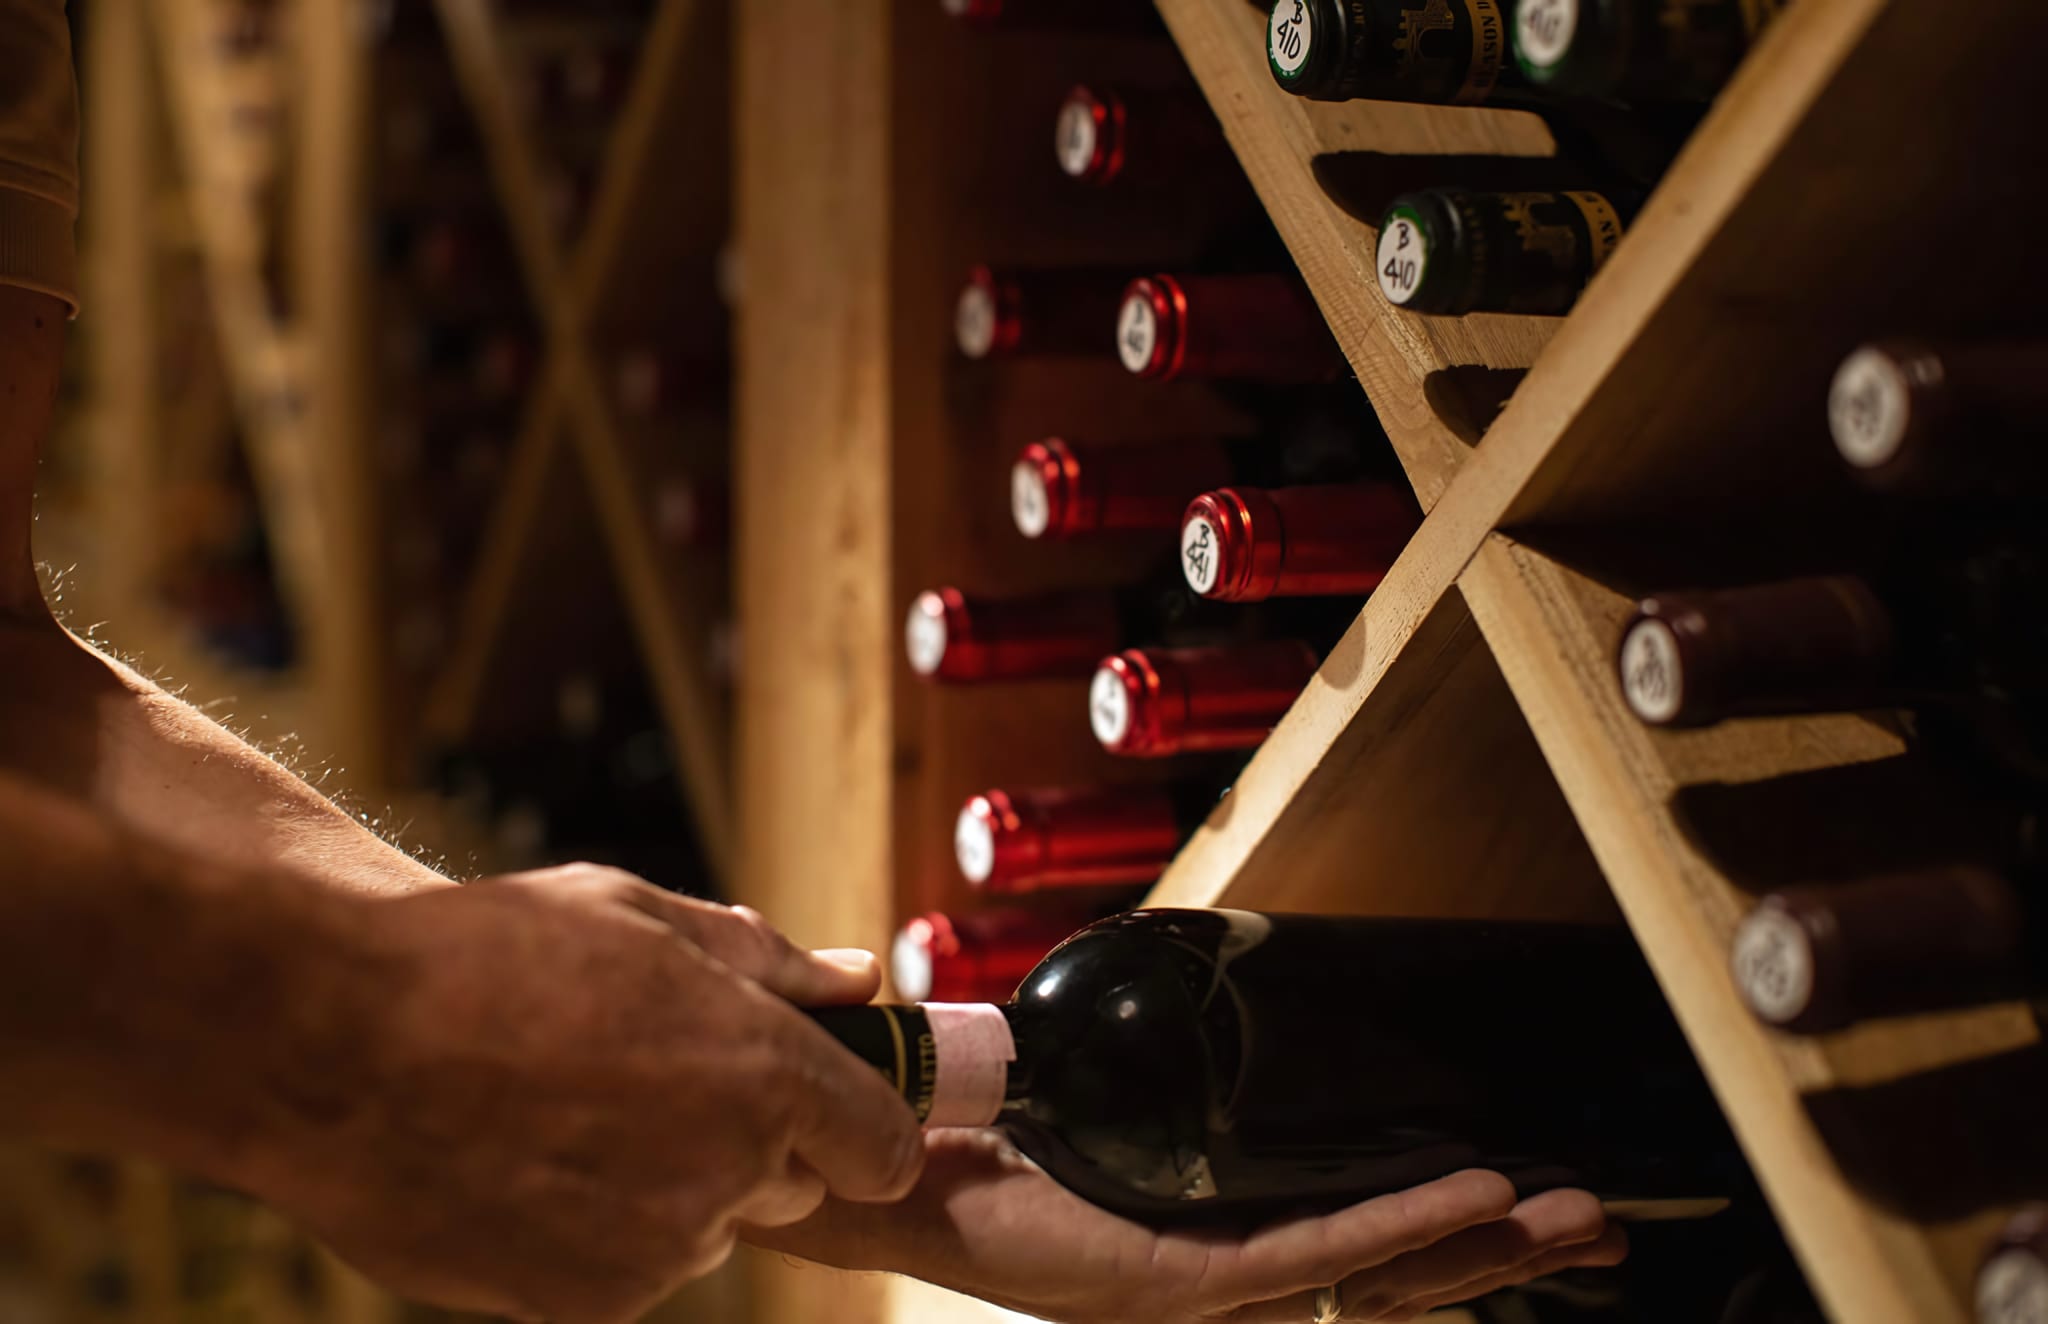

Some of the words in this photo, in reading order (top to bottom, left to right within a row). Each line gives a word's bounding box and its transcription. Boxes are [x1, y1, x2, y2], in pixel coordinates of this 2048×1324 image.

[1277, 19, 1301, 59] 410
[1396, 222, 1410, 252] B
[1384, 256, 1416, 290] 410
